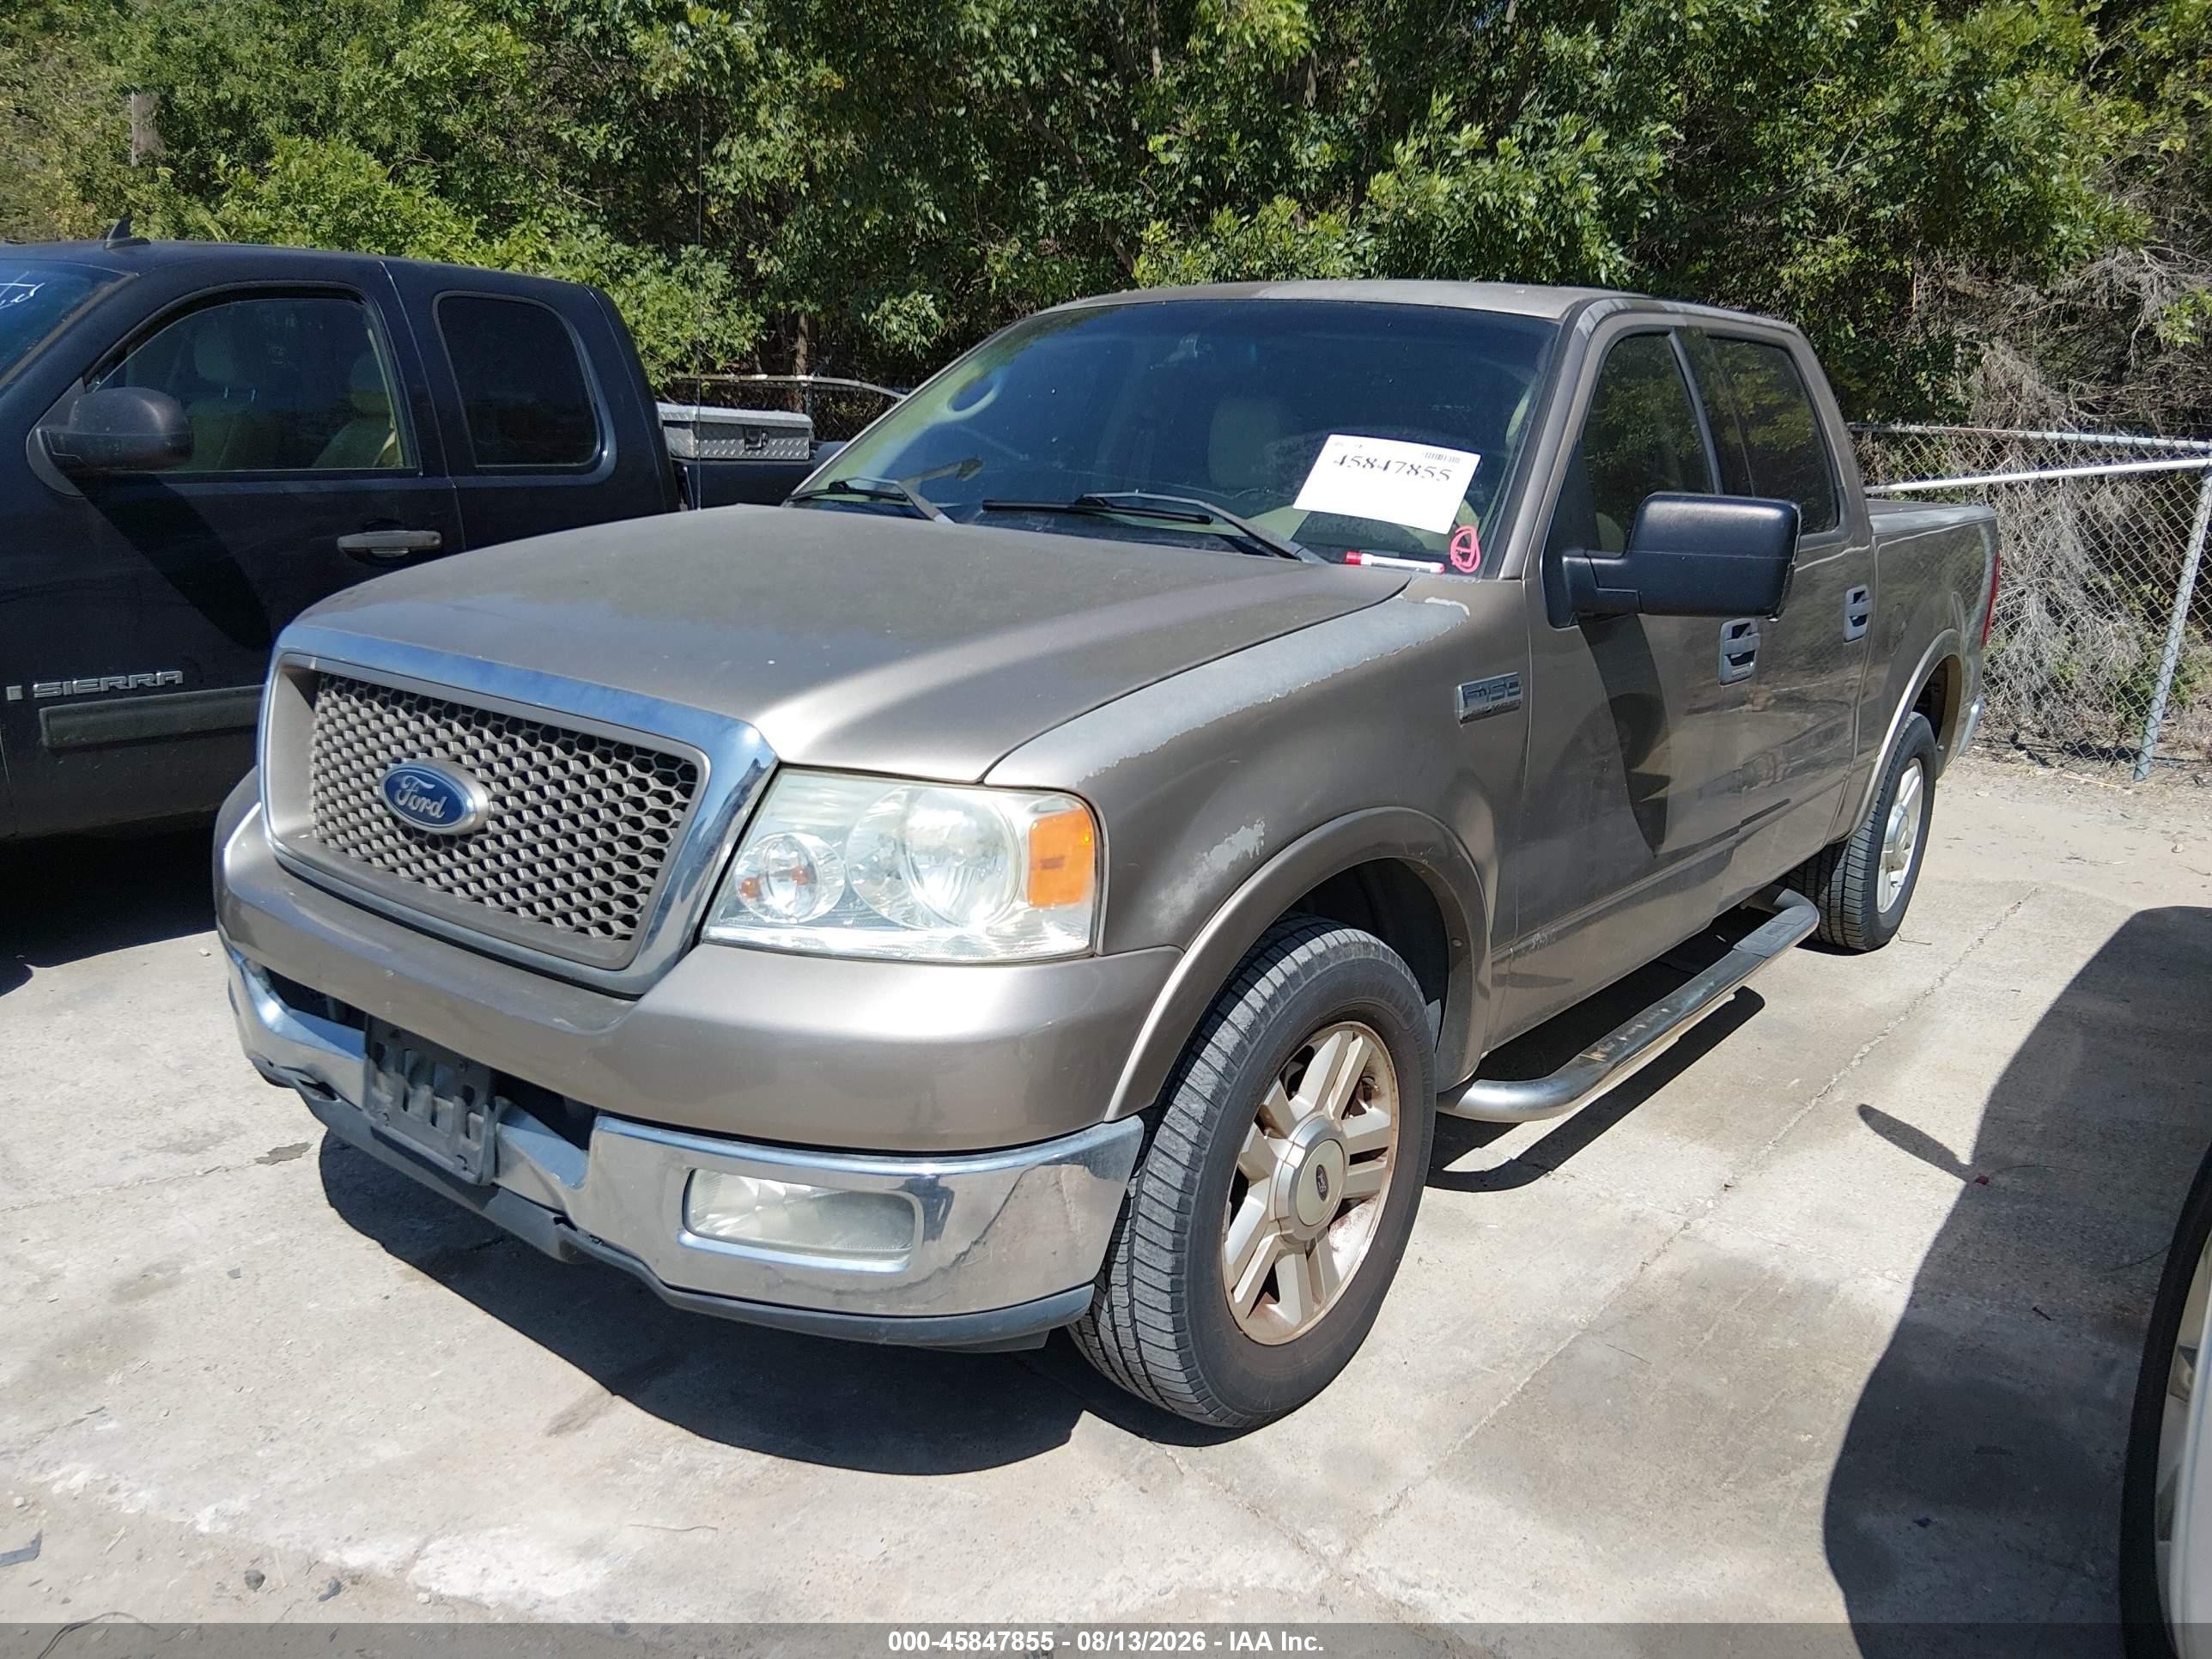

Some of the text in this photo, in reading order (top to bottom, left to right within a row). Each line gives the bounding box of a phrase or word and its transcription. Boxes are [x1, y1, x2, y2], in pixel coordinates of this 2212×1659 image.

[1333, 453, 1453, 482] 45847855
[33, 670, 184, 698] SIERRA
[394, 775, 448, 818] Ford
